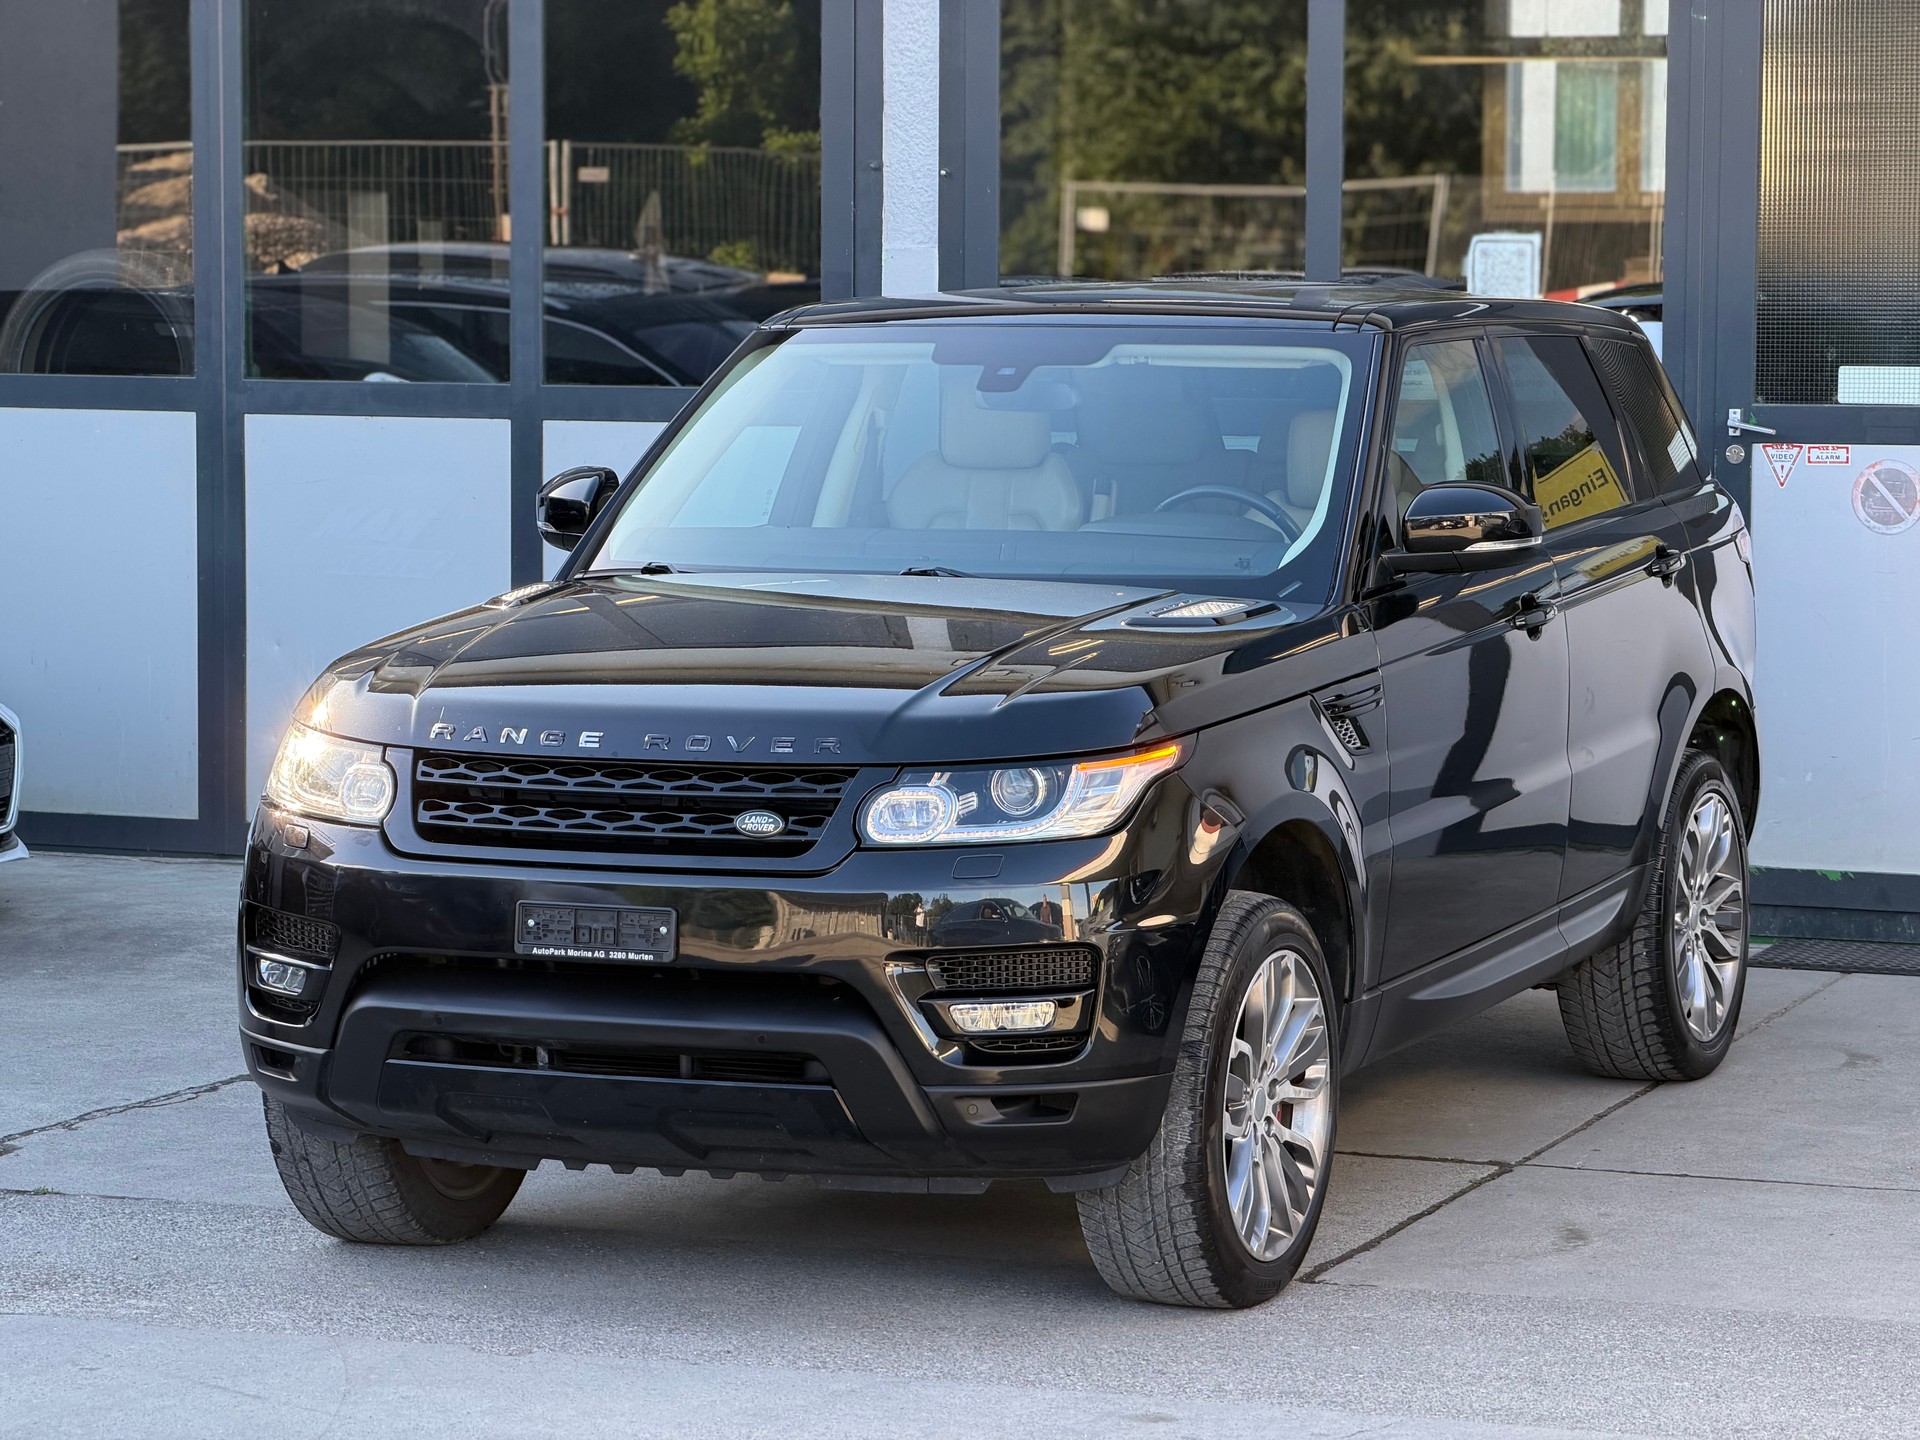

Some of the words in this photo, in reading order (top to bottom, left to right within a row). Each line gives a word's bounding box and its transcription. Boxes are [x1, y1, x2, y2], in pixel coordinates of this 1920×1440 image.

[429, 722, 604, 748] RANGE
[643, 733, 841, 754] ROVER
[744, 816, 768, 824] LAND
[746, 823, 775, 831] ROVER
[532, 947, 566, 956] AutoPark
[567, 949, 592, 957] Morina
[609, 951, 626, 959] 3280
[628, 952, 654, 961] Murten
